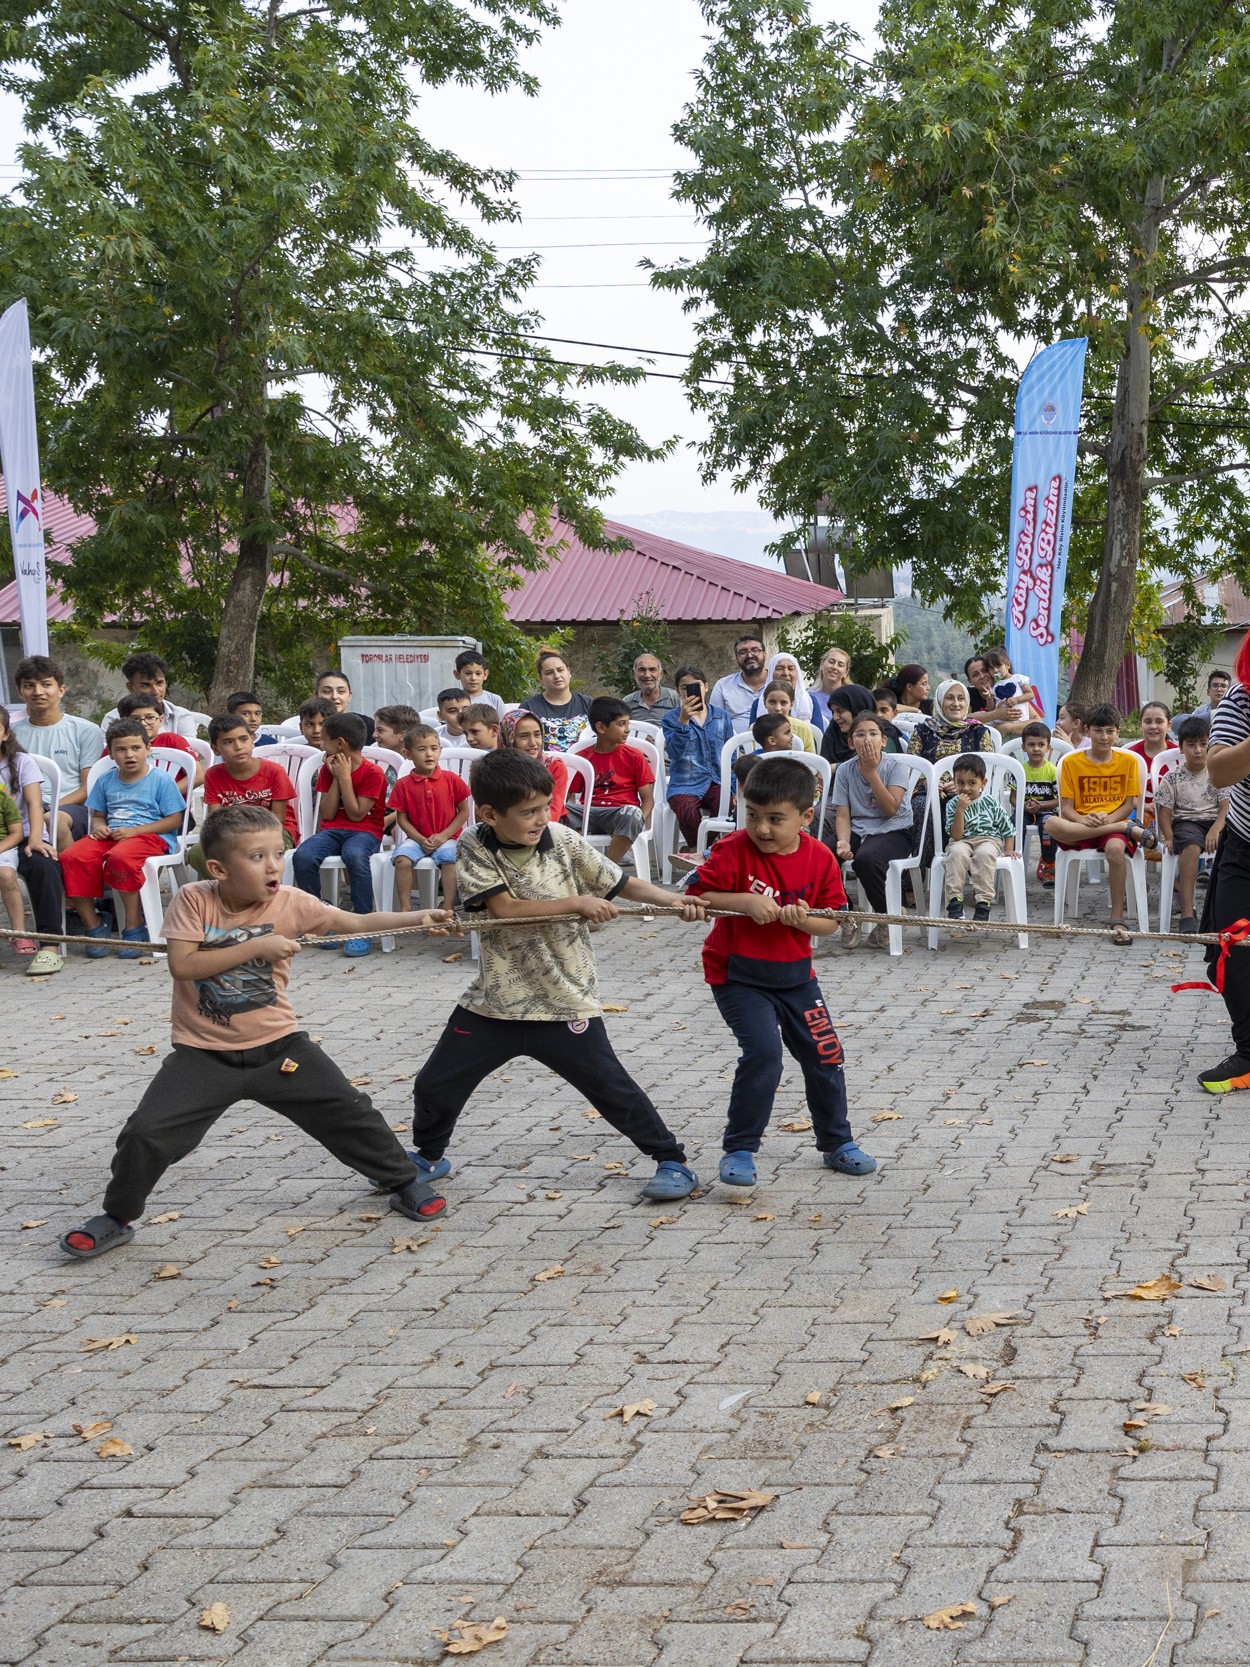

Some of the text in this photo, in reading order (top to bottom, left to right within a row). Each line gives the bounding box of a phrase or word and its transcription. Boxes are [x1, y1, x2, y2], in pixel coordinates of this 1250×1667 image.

[1012, 486, 1038, 630] Köy Bizim
[1029, 475, 1062, 646] Şenlik Bizim
[361, 652, 430, 664] TOROSLAR BELEDİYESİ
[1083, 776, 1121, 796] 1905
